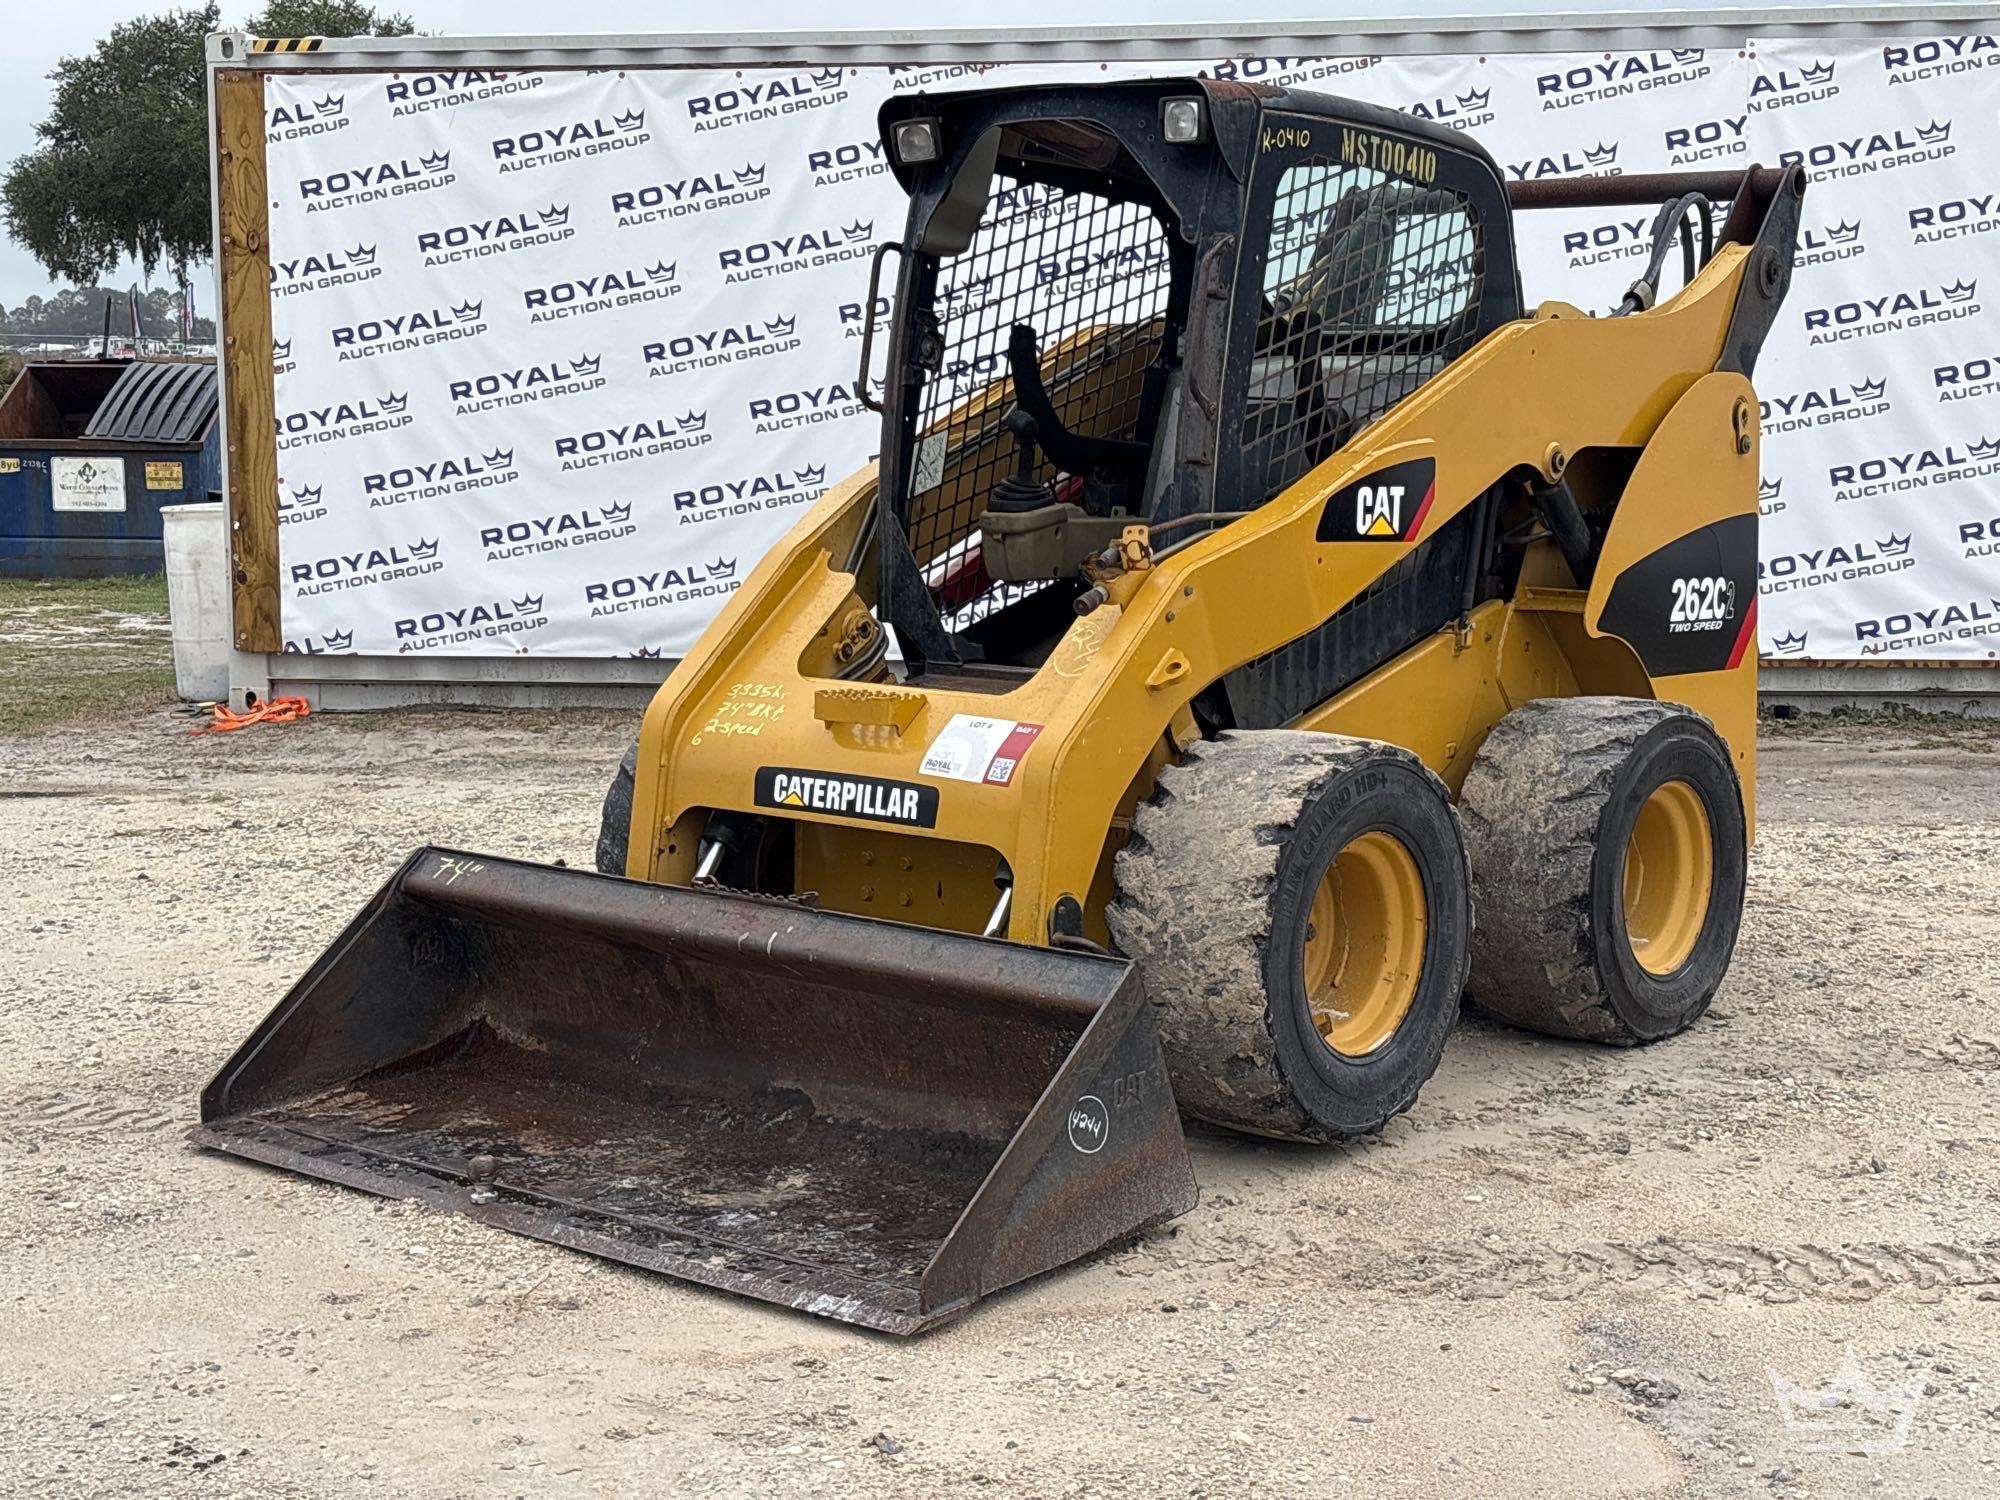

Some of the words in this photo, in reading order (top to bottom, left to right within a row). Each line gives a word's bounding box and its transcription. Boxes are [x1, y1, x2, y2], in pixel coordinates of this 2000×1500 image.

[1312, 55, 1382, 79] GROUP
[1537, 53, 1671, 96] ROYAL
[1889, 58, 1982, 86] AUCTION
[393, 91, 474, 118] AUCTION
[477, 77, 544, 99] GROUP
[688, 77, 812, 118] ROYAL
[1543, 83, 1633, 111] AUCTION
[1638, 67, 1710, 90] GROUP
[1766, 86, 1840, 110] GROUP
[285, 118, 349, 139] GROUP
[694, 106, 777, 133] AUCTION
[782, 91, 848, 114] GROUP
[492, 119, 615, 159] ROYAL
[499, 148, 581, 174] AUCTION
[585, 134, 650, 155] GROUP
[1341, 127, 1437, 183] MST00410
[1882, 146, 1955, 168] GROUP
[300, 160, 421, 199] ROYAL
[307, 188, 387, 213] AUCTION
[391, 174, 455, 196] GROUP
[612, 174, 734, 213] ROYAL
[618, 202, 700, 228] AUCTION
[705, 188, 770, 209] GROUP
[418, 214, 539, 252] ROYAL
[425, 242, 506, 267] AUCTION
[510, 228, 575, 249] GROUP
[719, 230, 842, 269] ROYAL
[726, 259, 808, 284] AUCTION
[812, 245, 879, 267] GROUP
[1793, 245, 1865, 268] GROUP
[318, 267, 382, 289] GROUP
[524, 271, 646, 309] ROYAL
[531, 299, 612, 323] AUCTION
[616, 285, 681, 306] GROUP
[1805, 290, 1941, 330] ROYAL
[332, 310, 452, 347] ROYAL
[339, 337, 419, 361] AUCTION
[423, 324, 487, 345] GROUP
[643, 325, 765, 363] ROYAL
[1810, 319, 1902, 346] AUCTION
[1907, 305, 1980, 327] GROUP
[650, 353, 731, 377] AUCTION
[736, 339, 800, 360] GROUP
[450, 363, 571, 401] ROYAL
[457, 391, 537, 415] AUCTION
[541, 378, 606, 398] GROUP
[756, 409, 838, 434] AUCTION
[1817, 402, 1890, 425] GROUP
[278, 428, 346, 450] UCTION
[349, 415, 413, 436] GROUP
[555, 420, 676, 457] ROYAL
[562, 447, 643, 471] AUCTION
[647, 434, 712, 455] GROUP
[1830, 447, 1966, 486] ROYAL
[364, 457, 484, 494] ROYAL
[370, 484, 451, 508] AUCTION
[455, 472, 518, 491] GROUP
[673, 474, 795, 511] ROYAL
[1835, 476, 1927, 502] AUCTION
[481, 511, 601, 547] ROYAL
[680, 501, 761, 525] AUCTION
[1356, 486, 1405, 535] CAT
[487, 538, 568, 561] AUCTION
[572, 525, 636, 545] GROUP
[291, 547, 409, 583] ROYAL
[297, 574, 377, 597] AUCTION
[381, 562, 443, 581] GROUP
[1760, 572, 1837, 594] UCTION
[1842, 558, 1915, 580] GROUP
[586, 567, 706, 603] ROYAL
[591, 594, 672, 617] AUCTION
[677, 581, 741, 601] GROUP
[395, 603, 513, 638] ROYAL
[401, 629, 481, 653] AUCTION
[484, 617, 548, 636] GROUP
[1669, 623, 1692, 633] TWO
[1691, 620, 1723, 632] SPEED
[1855, 602, 1991, 640] ROYAL
[1861, 630, 1953, 655] AUCTION
[691, 731, 703, 746] 6
[969, 720, 987, 729] LOT
[1016, 726, 1033, 734] DAY
[926, 758, 952, 770] ROYAL
[773, 773, 919, 820] CATERPILLAR
[432, 857, 485, 886] 74"
[1071, 1110, 1102, 1139] 4244
